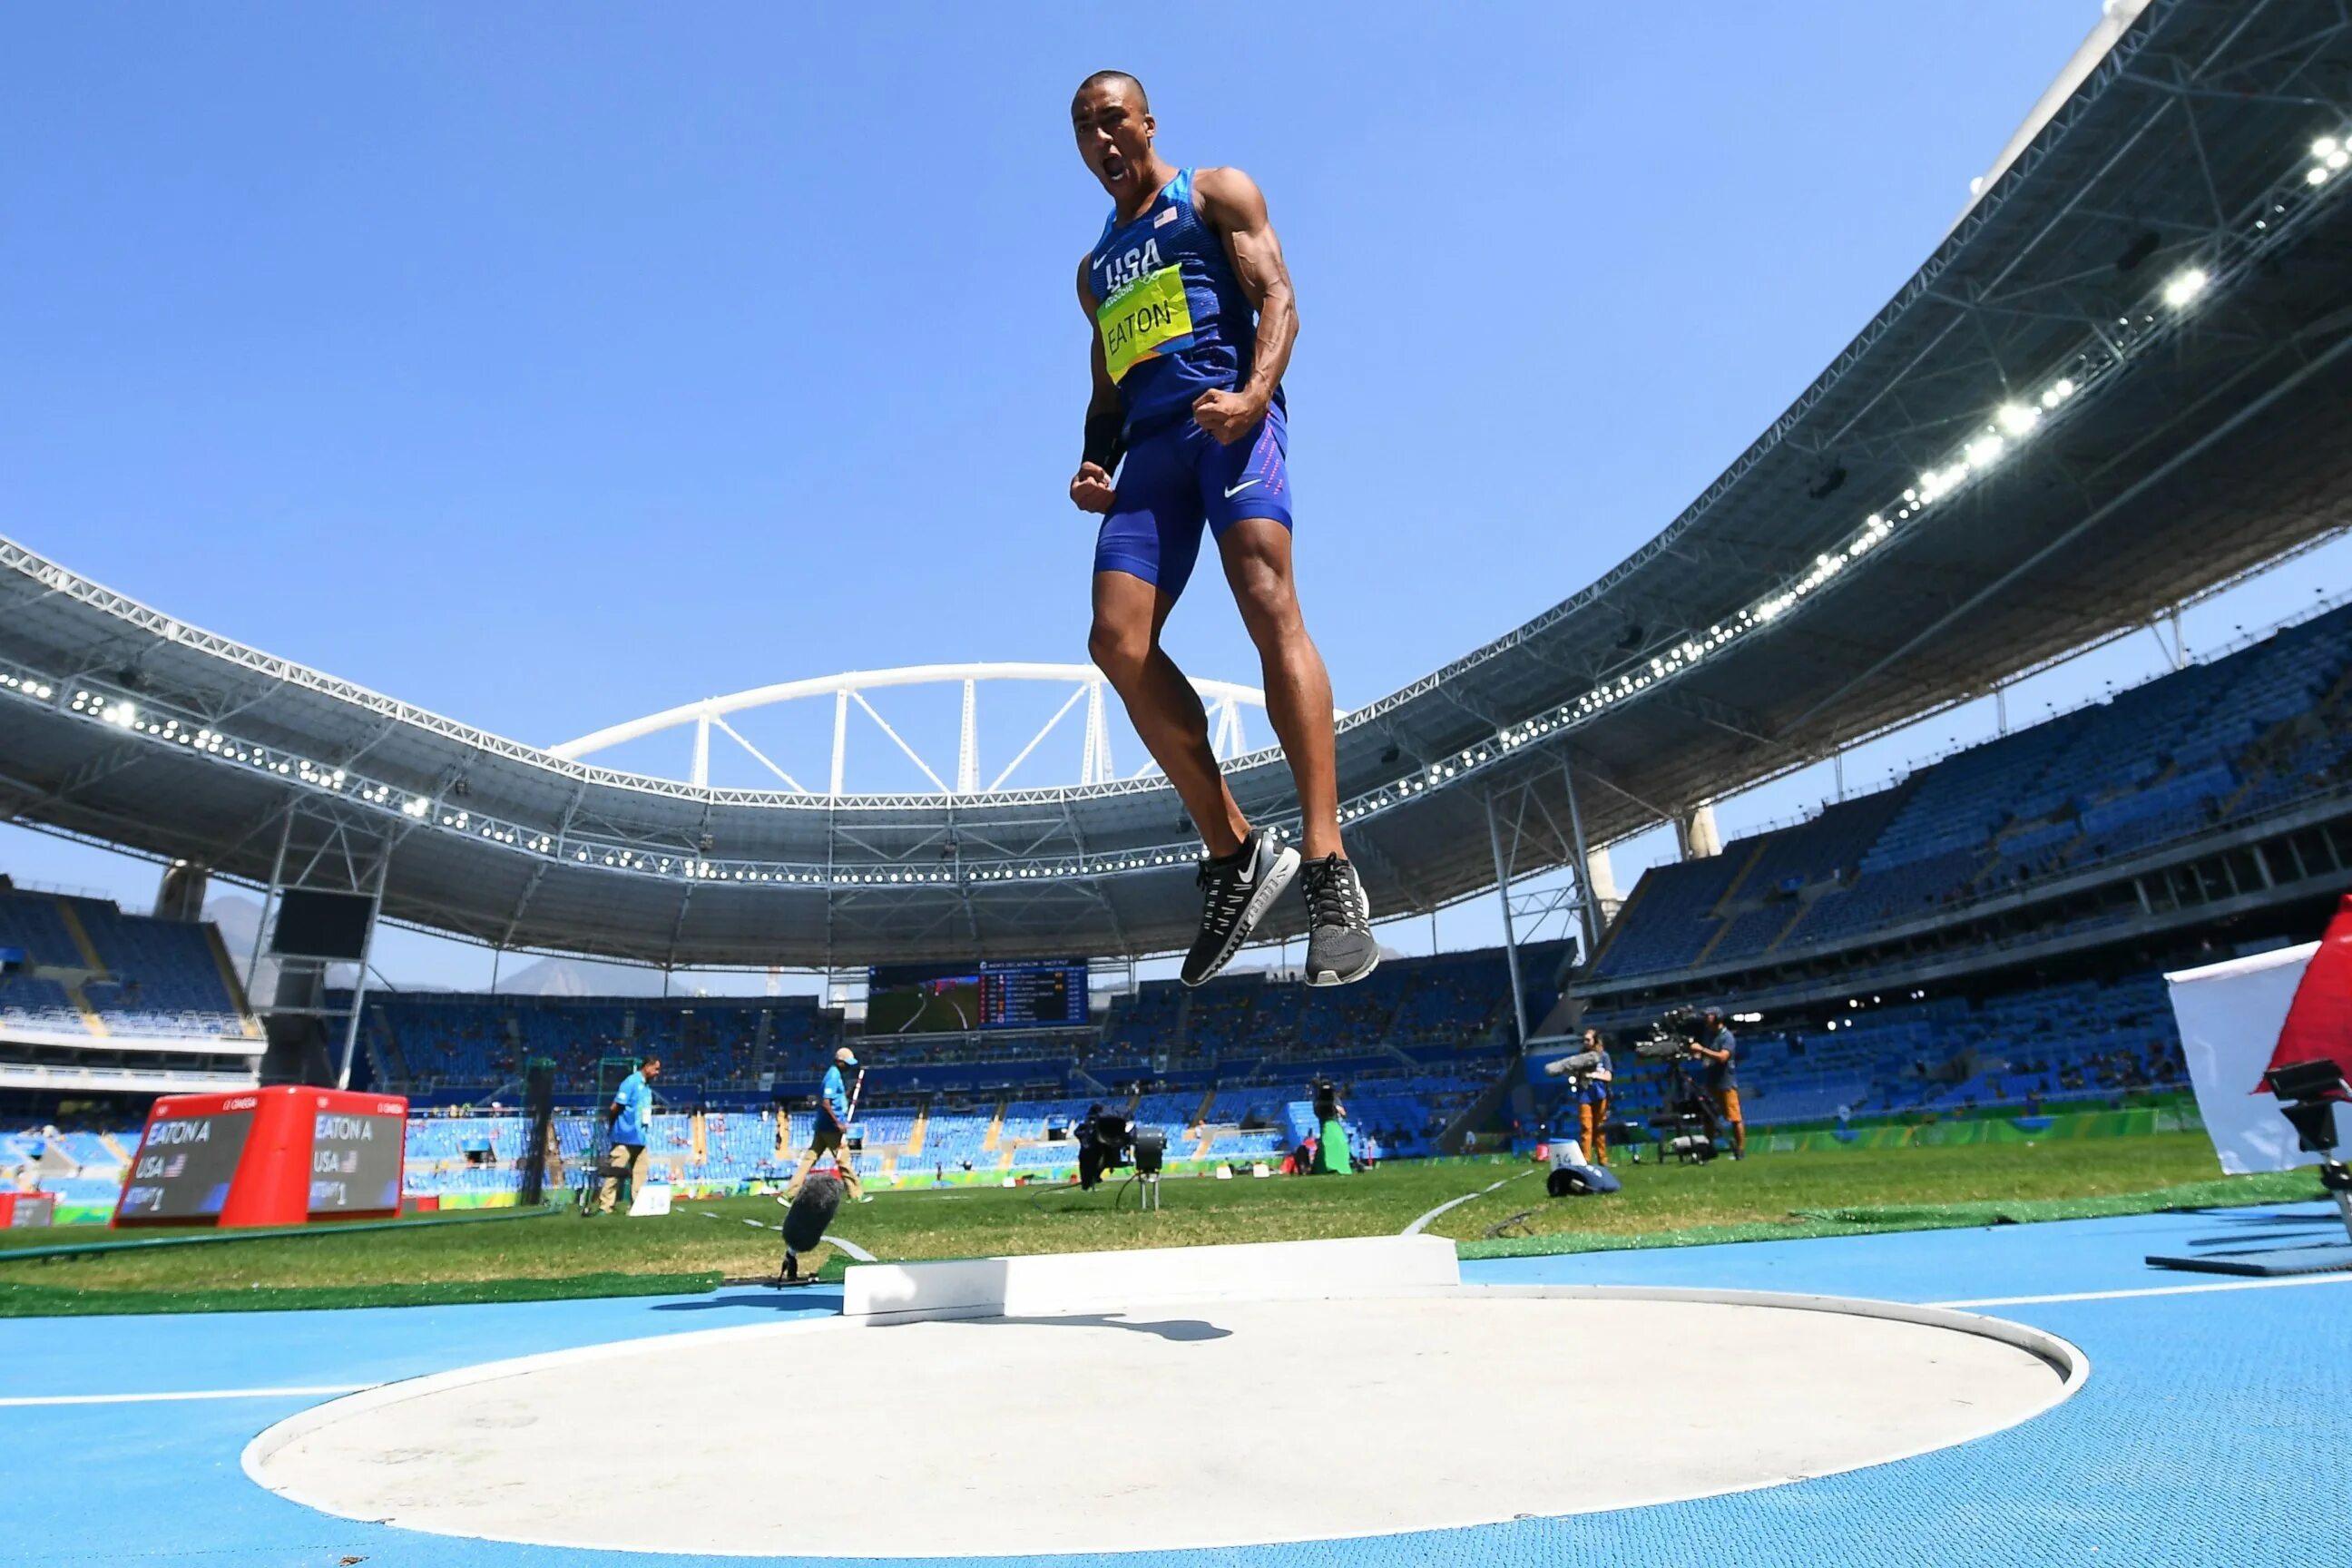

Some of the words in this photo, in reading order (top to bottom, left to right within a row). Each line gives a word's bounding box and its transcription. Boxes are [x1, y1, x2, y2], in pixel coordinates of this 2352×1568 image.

[1106, 238, 1163, 293] USA
[1108, 300, 1172, 356] EATON
[145, 1120, 197, 1146] EATON
[194, 1118, 211, 1142] A
[315, 1114, 361, 1140] EATON
[360, 1120, 373, 1142] A
[136, 1155, 166, 1179] USA
[313, 1150, 339, 1172] USA
